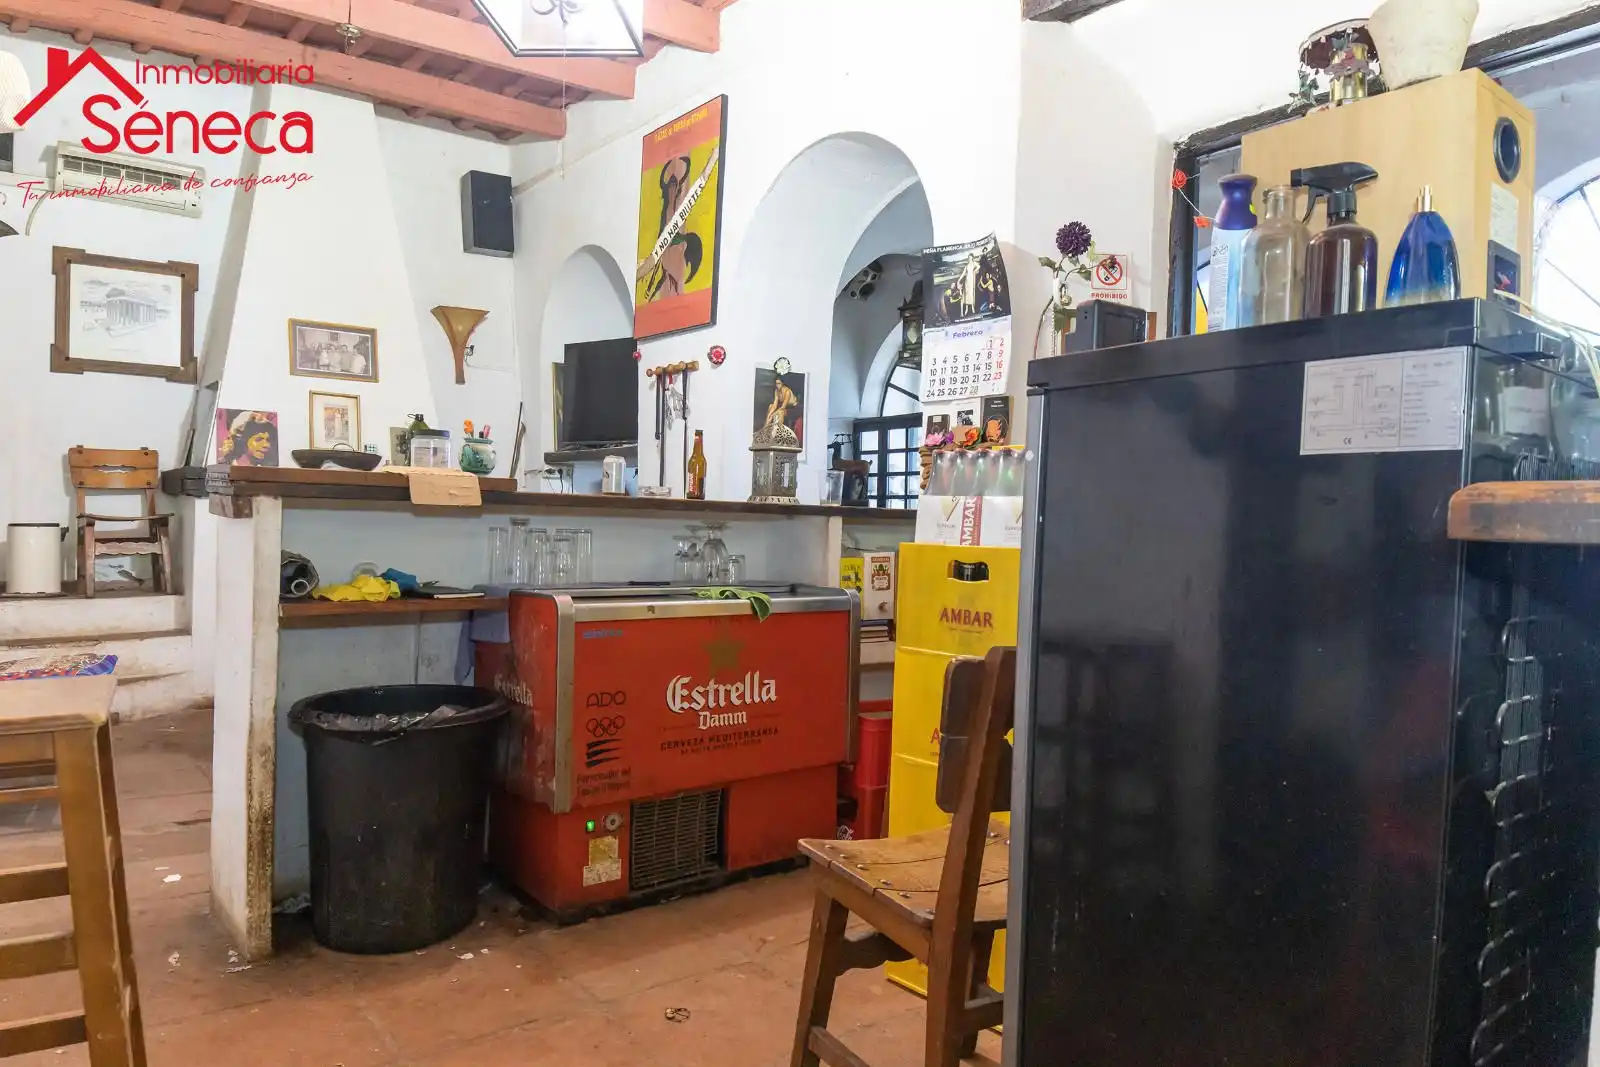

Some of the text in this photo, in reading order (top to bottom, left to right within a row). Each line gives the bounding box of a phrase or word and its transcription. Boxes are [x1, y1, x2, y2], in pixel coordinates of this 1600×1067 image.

[654, 250, 660, 258] Y
[658, 237, 669, 252] NO
[667, 220, 680, 239] HAY
[952, 330, 983, 338] Febrero
[932, 358, 936, 366] 3
[952, 355, 958, 363] 5
[964, 354, 970, 362] 6
[976, 352, 980, 360] 7
[930, 368, 937, 376] 10
[985, 362, 992, 370] 15
[996, 360, 1003, 368] 16
[930, 380, 936, 388] 17
[950, 376, 957, 384] 19
[960, 376, 970, 384] 20
[972, 374, 980, 382] 21
[982, 373, 992, 382] 22
[994, 372, 1002, 380] 23
[926, 390, 935, 398] 24
[948, 388, 957, 396] 26
[959, 386, 968, 395] 27
[961, 496, 977, 547] AMBAR
[939, 607, 994, 629] AMBAR
[586, 690, 627, 708] ADO
[666, 670, 779, 713] Estrella
[698, 711, 748, 730] Damm
[660, 737, 704, 752] CERVEZA
